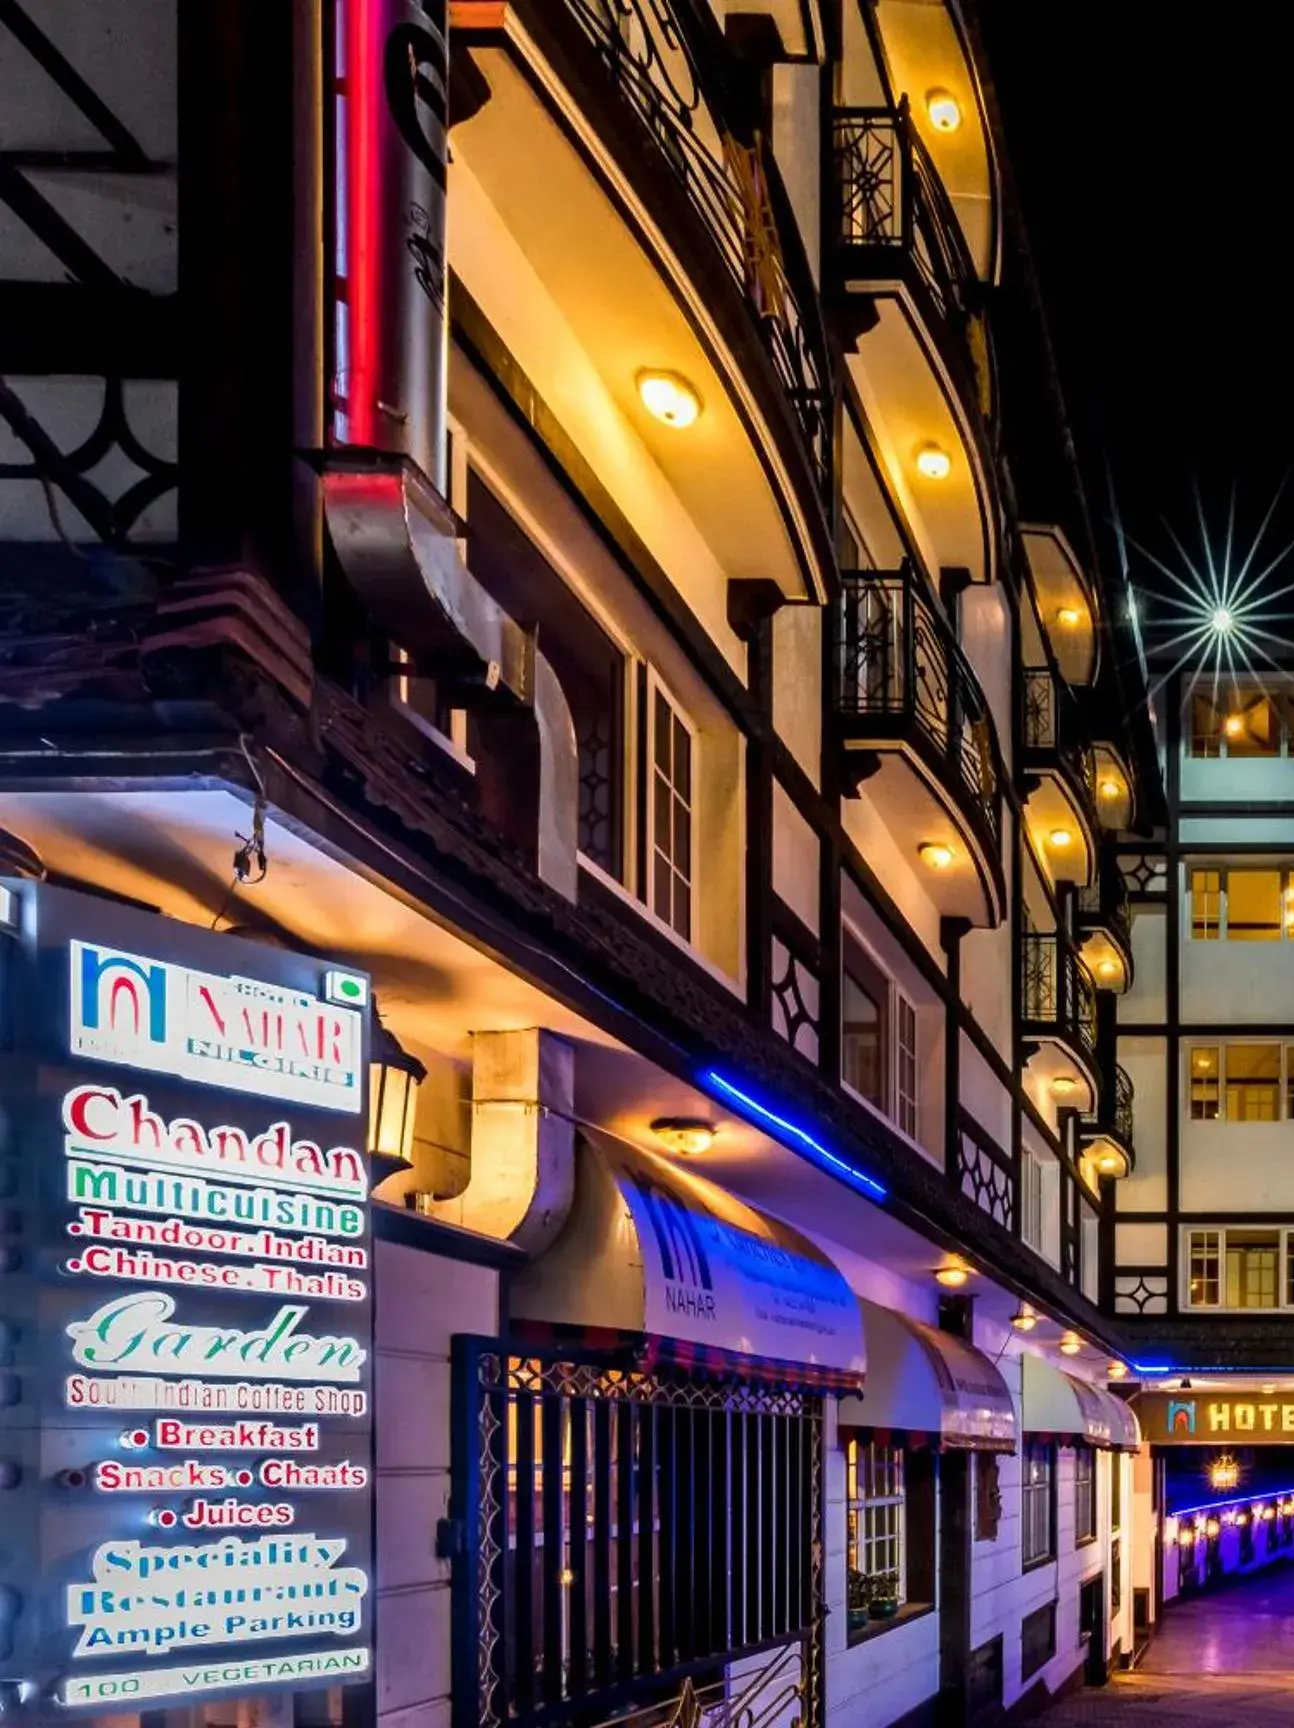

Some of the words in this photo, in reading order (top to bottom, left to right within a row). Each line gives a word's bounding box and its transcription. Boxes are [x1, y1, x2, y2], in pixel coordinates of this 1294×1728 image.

[69, 1091, 363, 1183] Chandan
[75, 1167, 360, 1234] Multicuisine
[84, 1212, 243, 1252] Tandoor
[263, 1235, 366, 1266] Indian
[84, 1248, 241, 1286] Chinese
[262, 1268, 363, 1298] Thalis
[665, 1286, 716, 1321] NAHAR
[80, 1298, 362, 1366] Garden
[237, 1386, 305, 1411] Coffee
[315, 1389, 364, 1415] Shop
[159, 1421, 317, 1448] Breakfast
[99, 1465, 225, 1489] Snacks
[262, 1463, 365, 1486] Chaats
[186, 1503, 291, 1526] Juices
[105, 1541, 336, 1578] Speciality
[81, 1580, 361, 1615] Restaurants
[86, 1621, 211, 1647] Ample
[226, 1610, 356, 1634] Parking
[182, 1654, 361, 1686] VEGETARIAN
